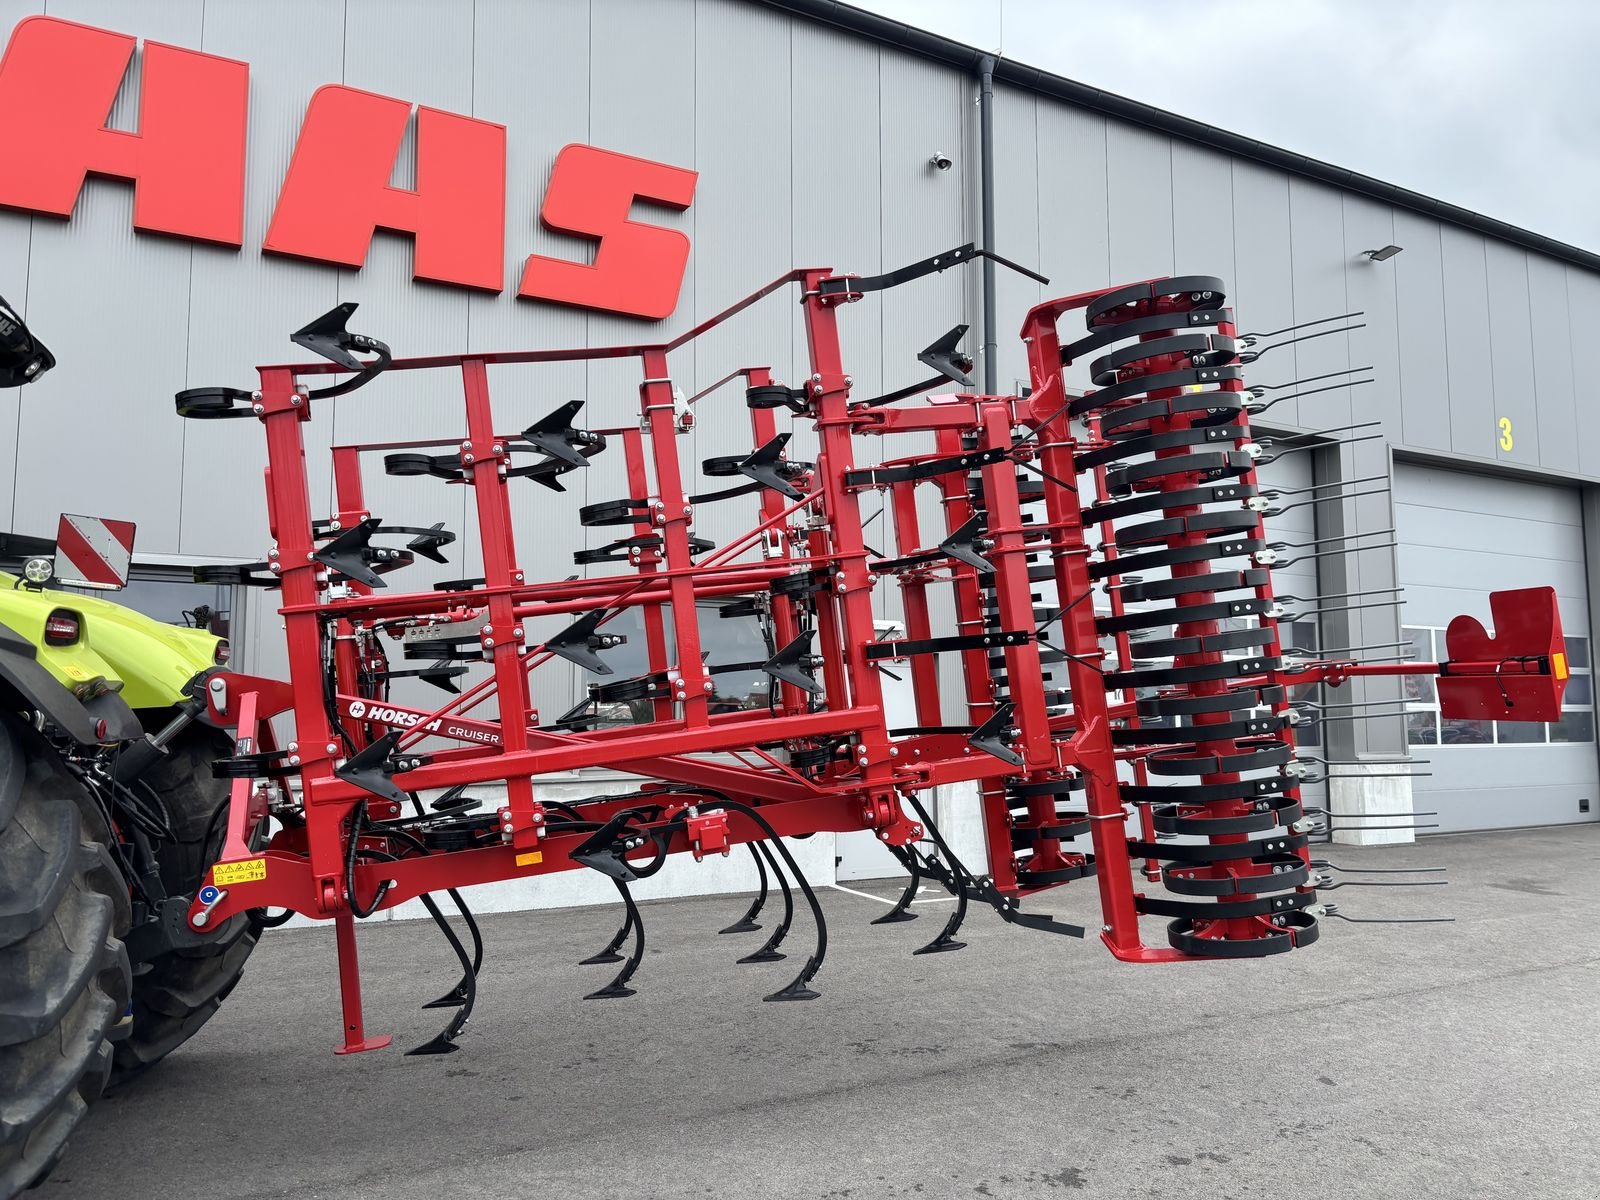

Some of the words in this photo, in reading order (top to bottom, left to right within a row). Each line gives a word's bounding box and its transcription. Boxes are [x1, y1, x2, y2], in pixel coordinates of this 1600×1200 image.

[0, 15, 698, 320] AAS
[1498, 416, 1513, 452] 3
[448, 726, 499, 743] CRUISER
